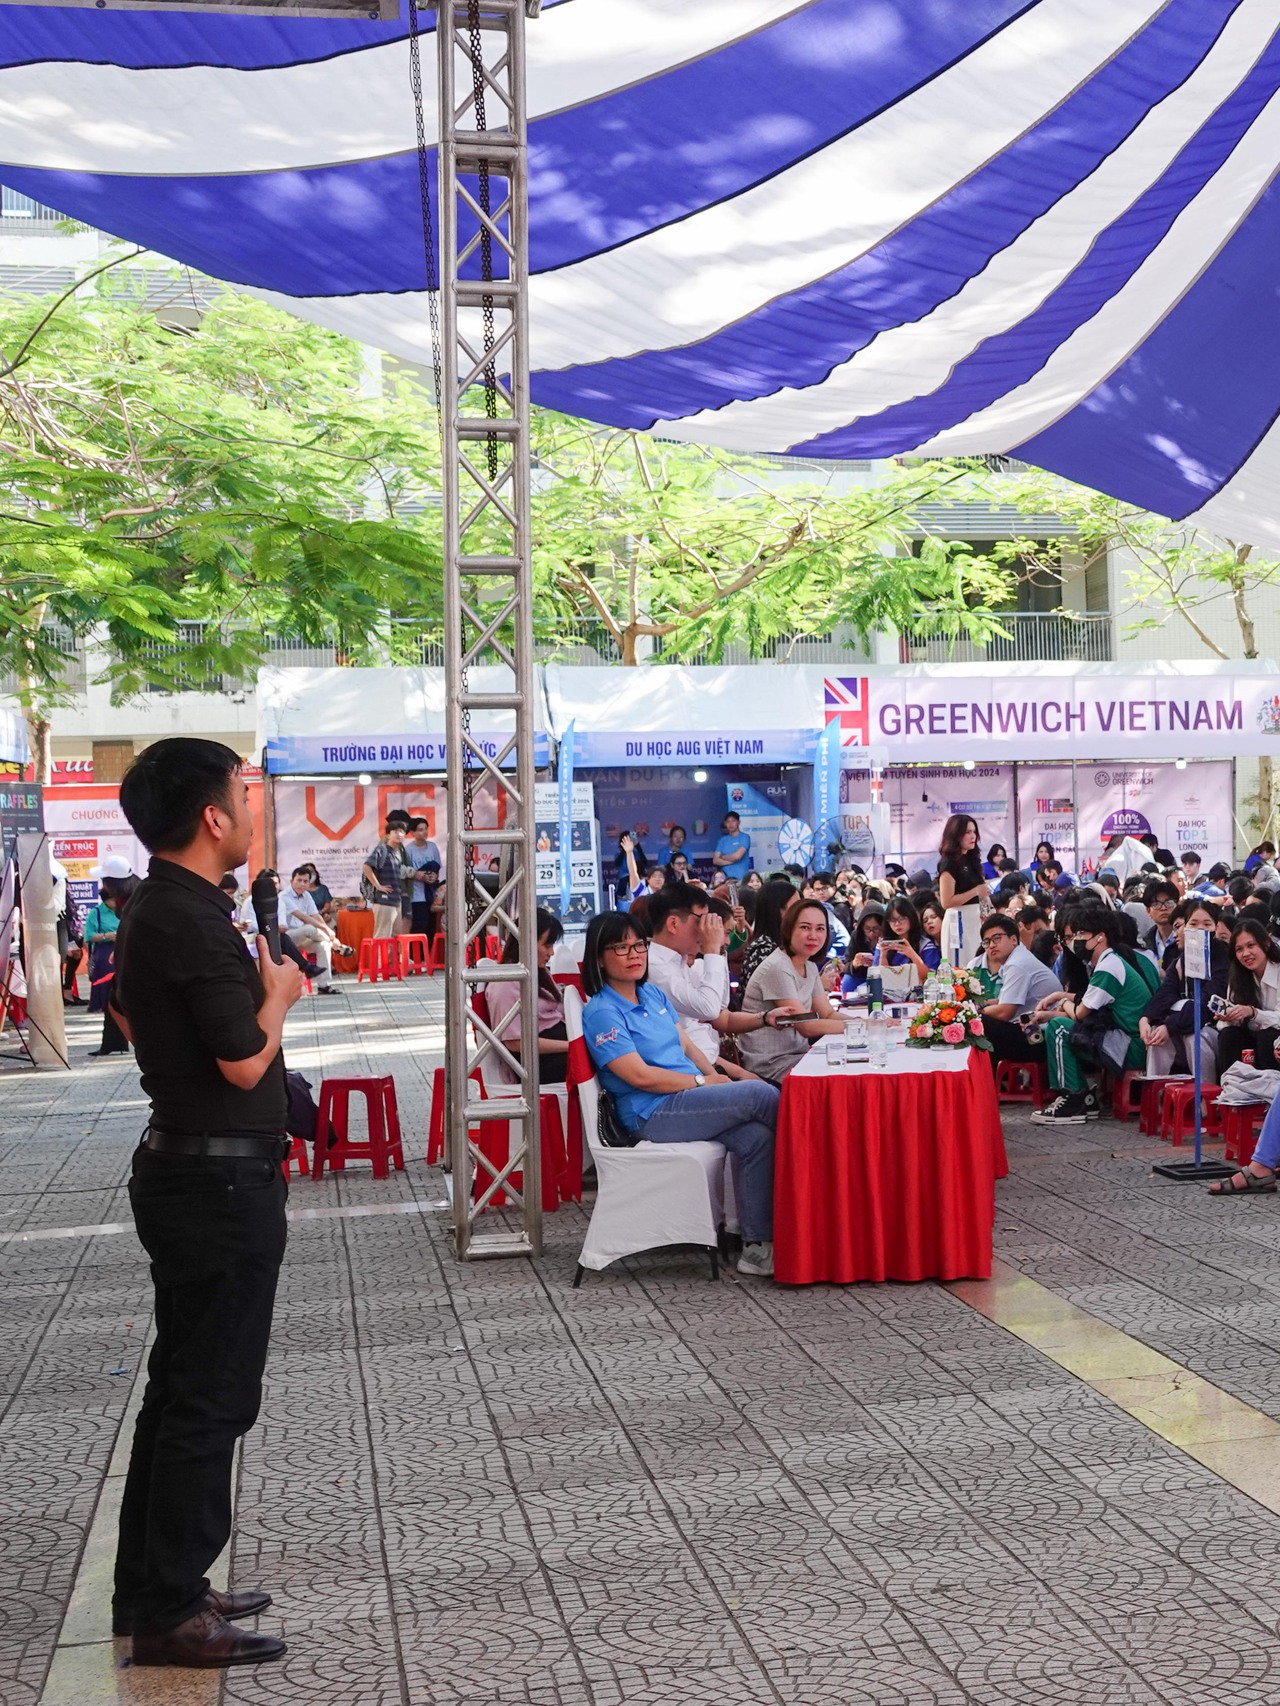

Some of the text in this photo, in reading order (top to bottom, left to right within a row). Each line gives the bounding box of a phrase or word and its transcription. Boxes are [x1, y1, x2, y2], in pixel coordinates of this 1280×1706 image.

[878, 700, 1243, 735] GREENWICH VIETNAM
[322, 742, 376, 762] TRƯỜNG
[380, 745, 405, 765] ĐẠI
[408, 744, 434, 764] HỌC
[626, 738, 764, 759] DU HỌC AUG VIỆT NAM
[920, 769, 940, 778] SINH
[979, 768, 1000, 777] 2024
[767, 786, 787, 796] AUG
[0, 793, 38, 809] RAFFLES
[1036, 799, 1052, 813] THE
[72, 810, 118, 820] CHƯƠNG
[1112, 813, 1140, 825] 100%
[843, 816, 870, 830] TOP 1
[1044, 822, 1056, 832] ĐẠI
[1178, 820, 1206, 830] ĐẠI HỌC
[1038, 832, 1062, 844] TOP
[1176, 830, 1208, 840] TOP 1
[540, 870, 553, 880] 29
[578, 868, 593, 878] 02
